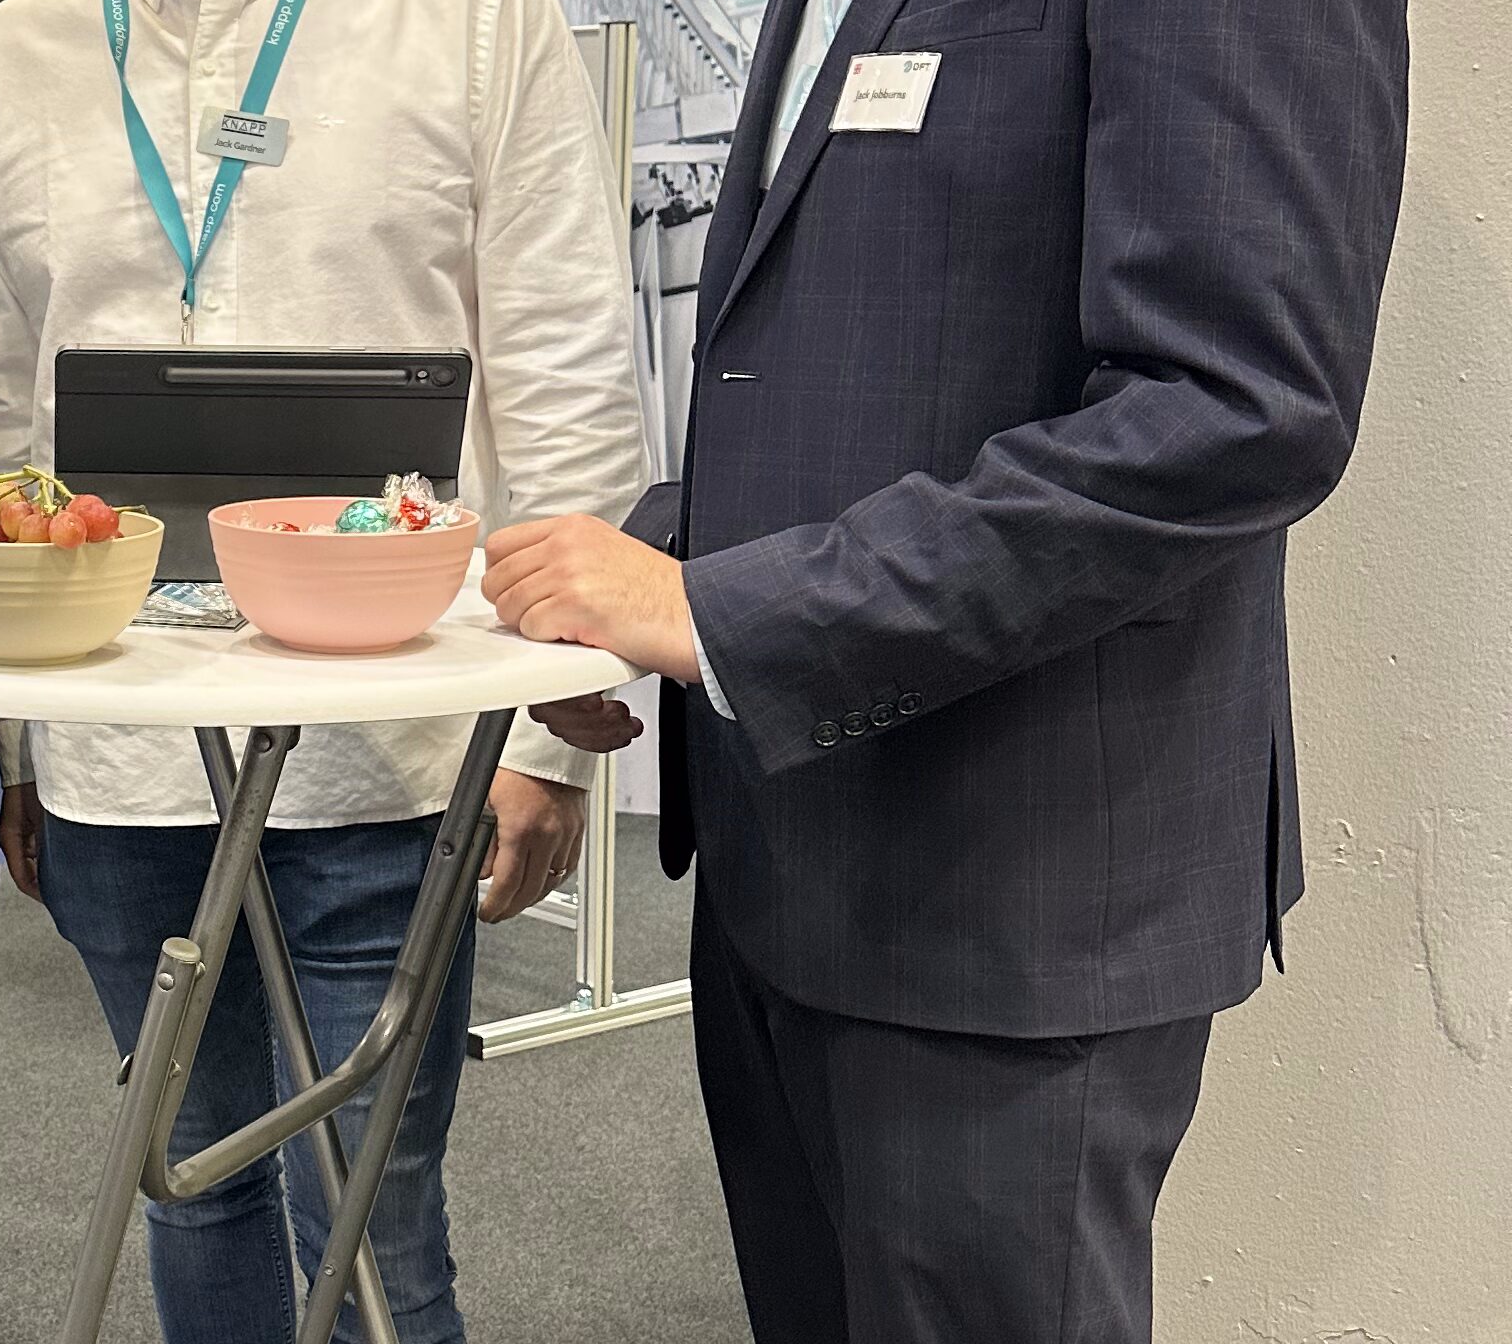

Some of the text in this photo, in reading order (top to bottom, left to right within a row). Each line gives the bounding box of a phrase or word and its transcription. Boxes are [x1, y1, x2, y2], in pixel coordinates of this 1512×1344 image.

[222, 118, 267, 133] KNAPP
[214, 138, 266, 154] Jack Gardner
